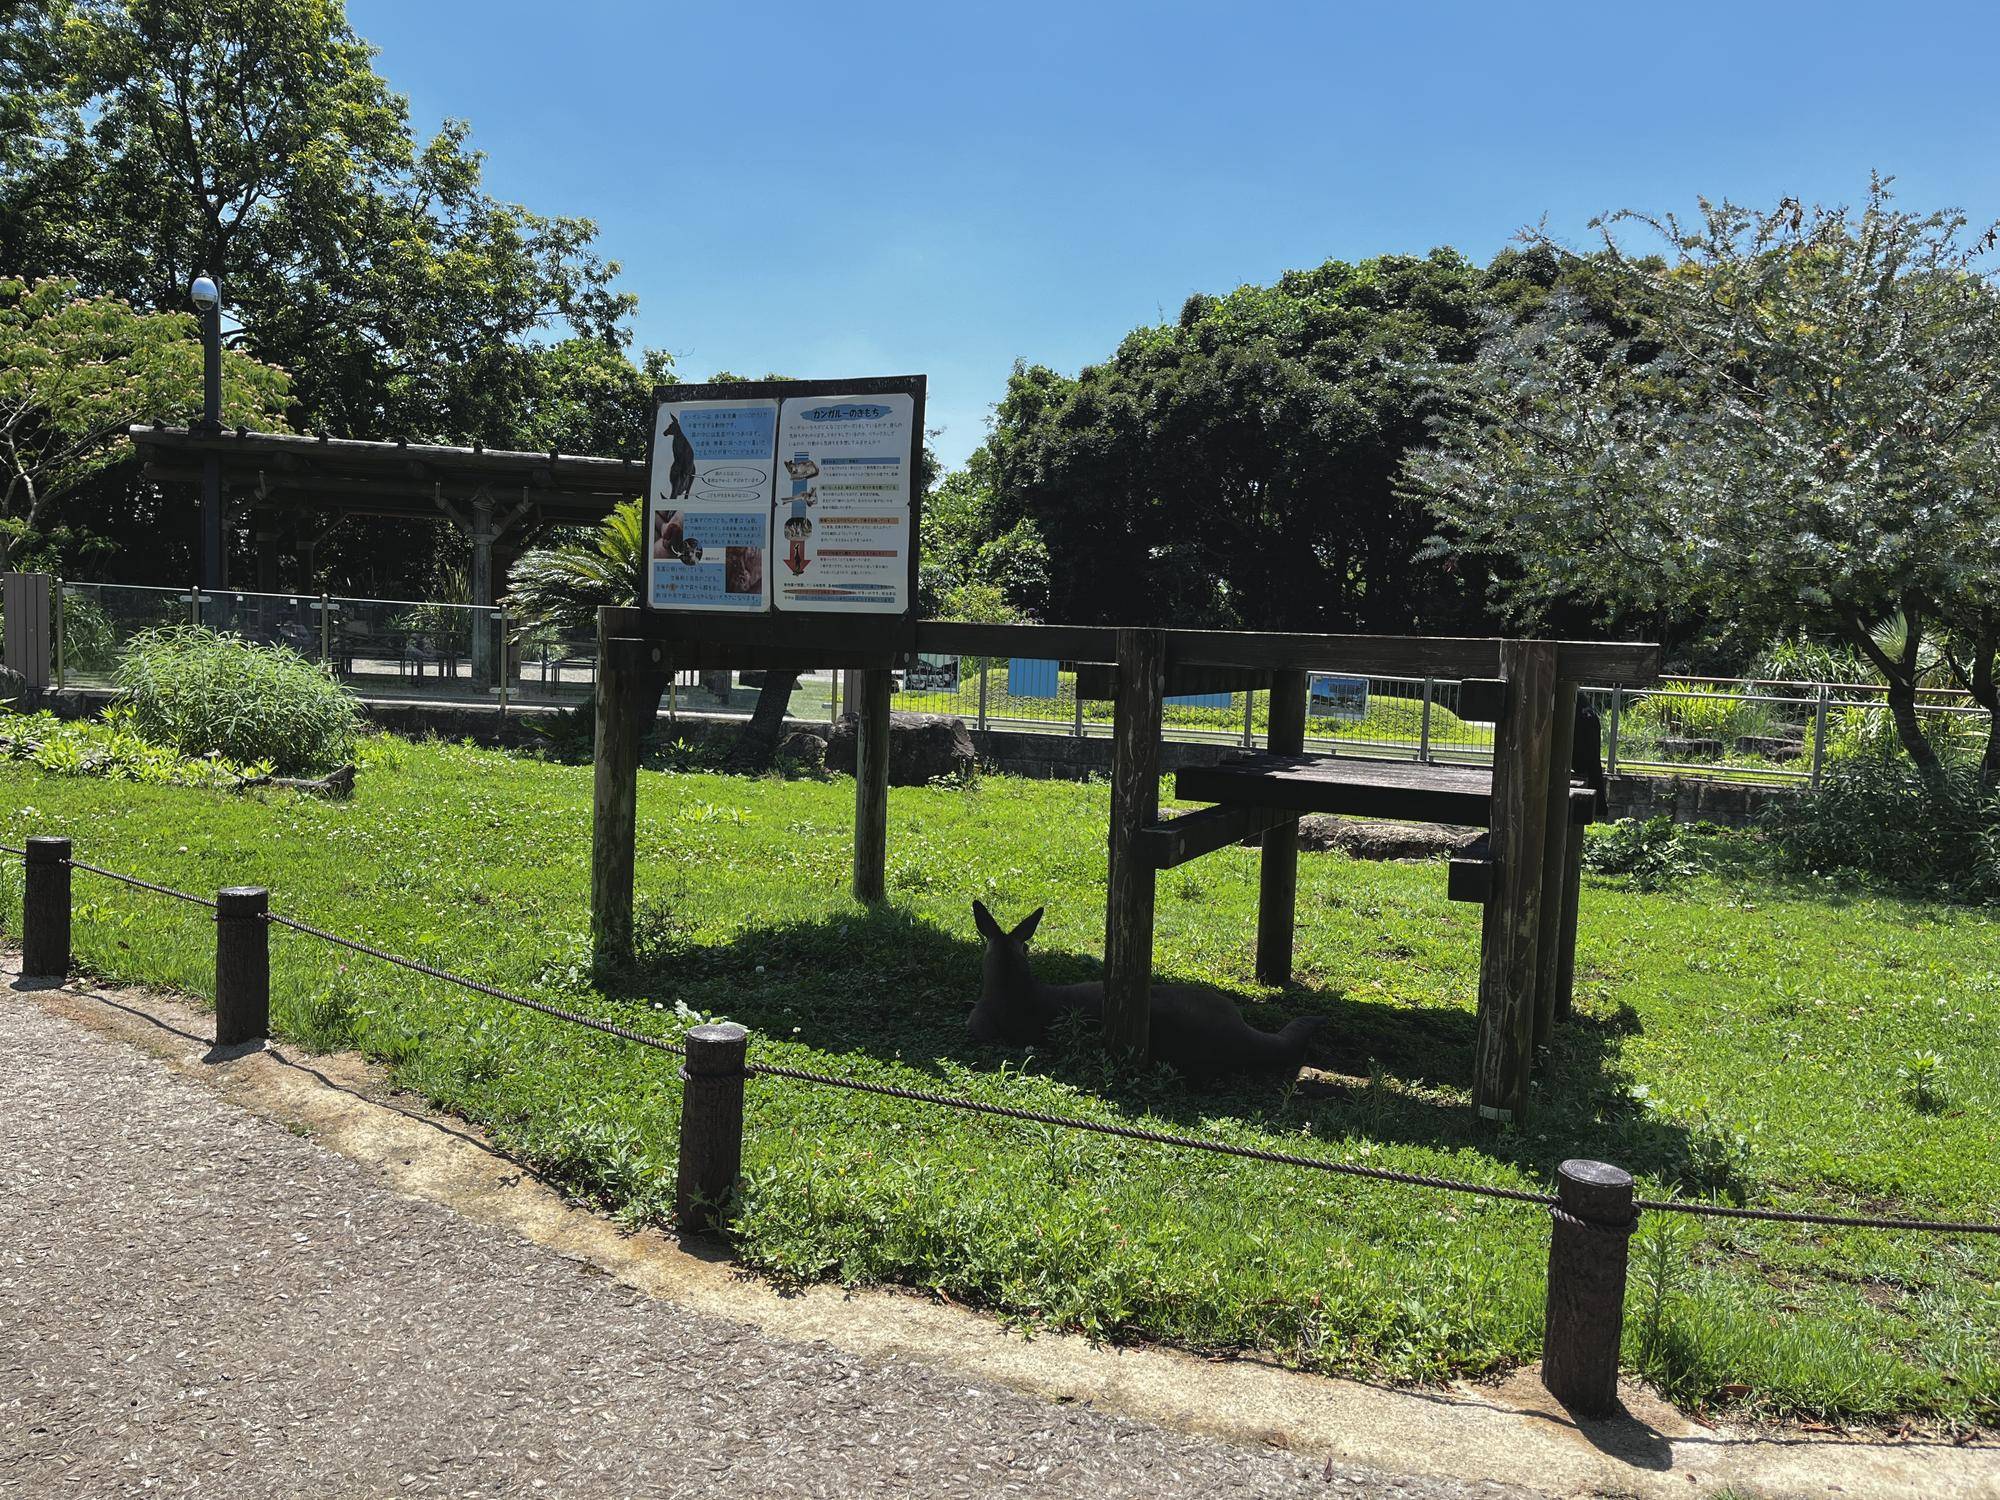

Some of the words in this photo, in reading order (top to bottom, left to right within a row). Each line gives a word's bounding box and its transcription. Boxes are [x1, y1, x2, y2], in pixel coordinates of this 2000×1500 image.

[813, 407, 880, 419] カンガルーのきもち
